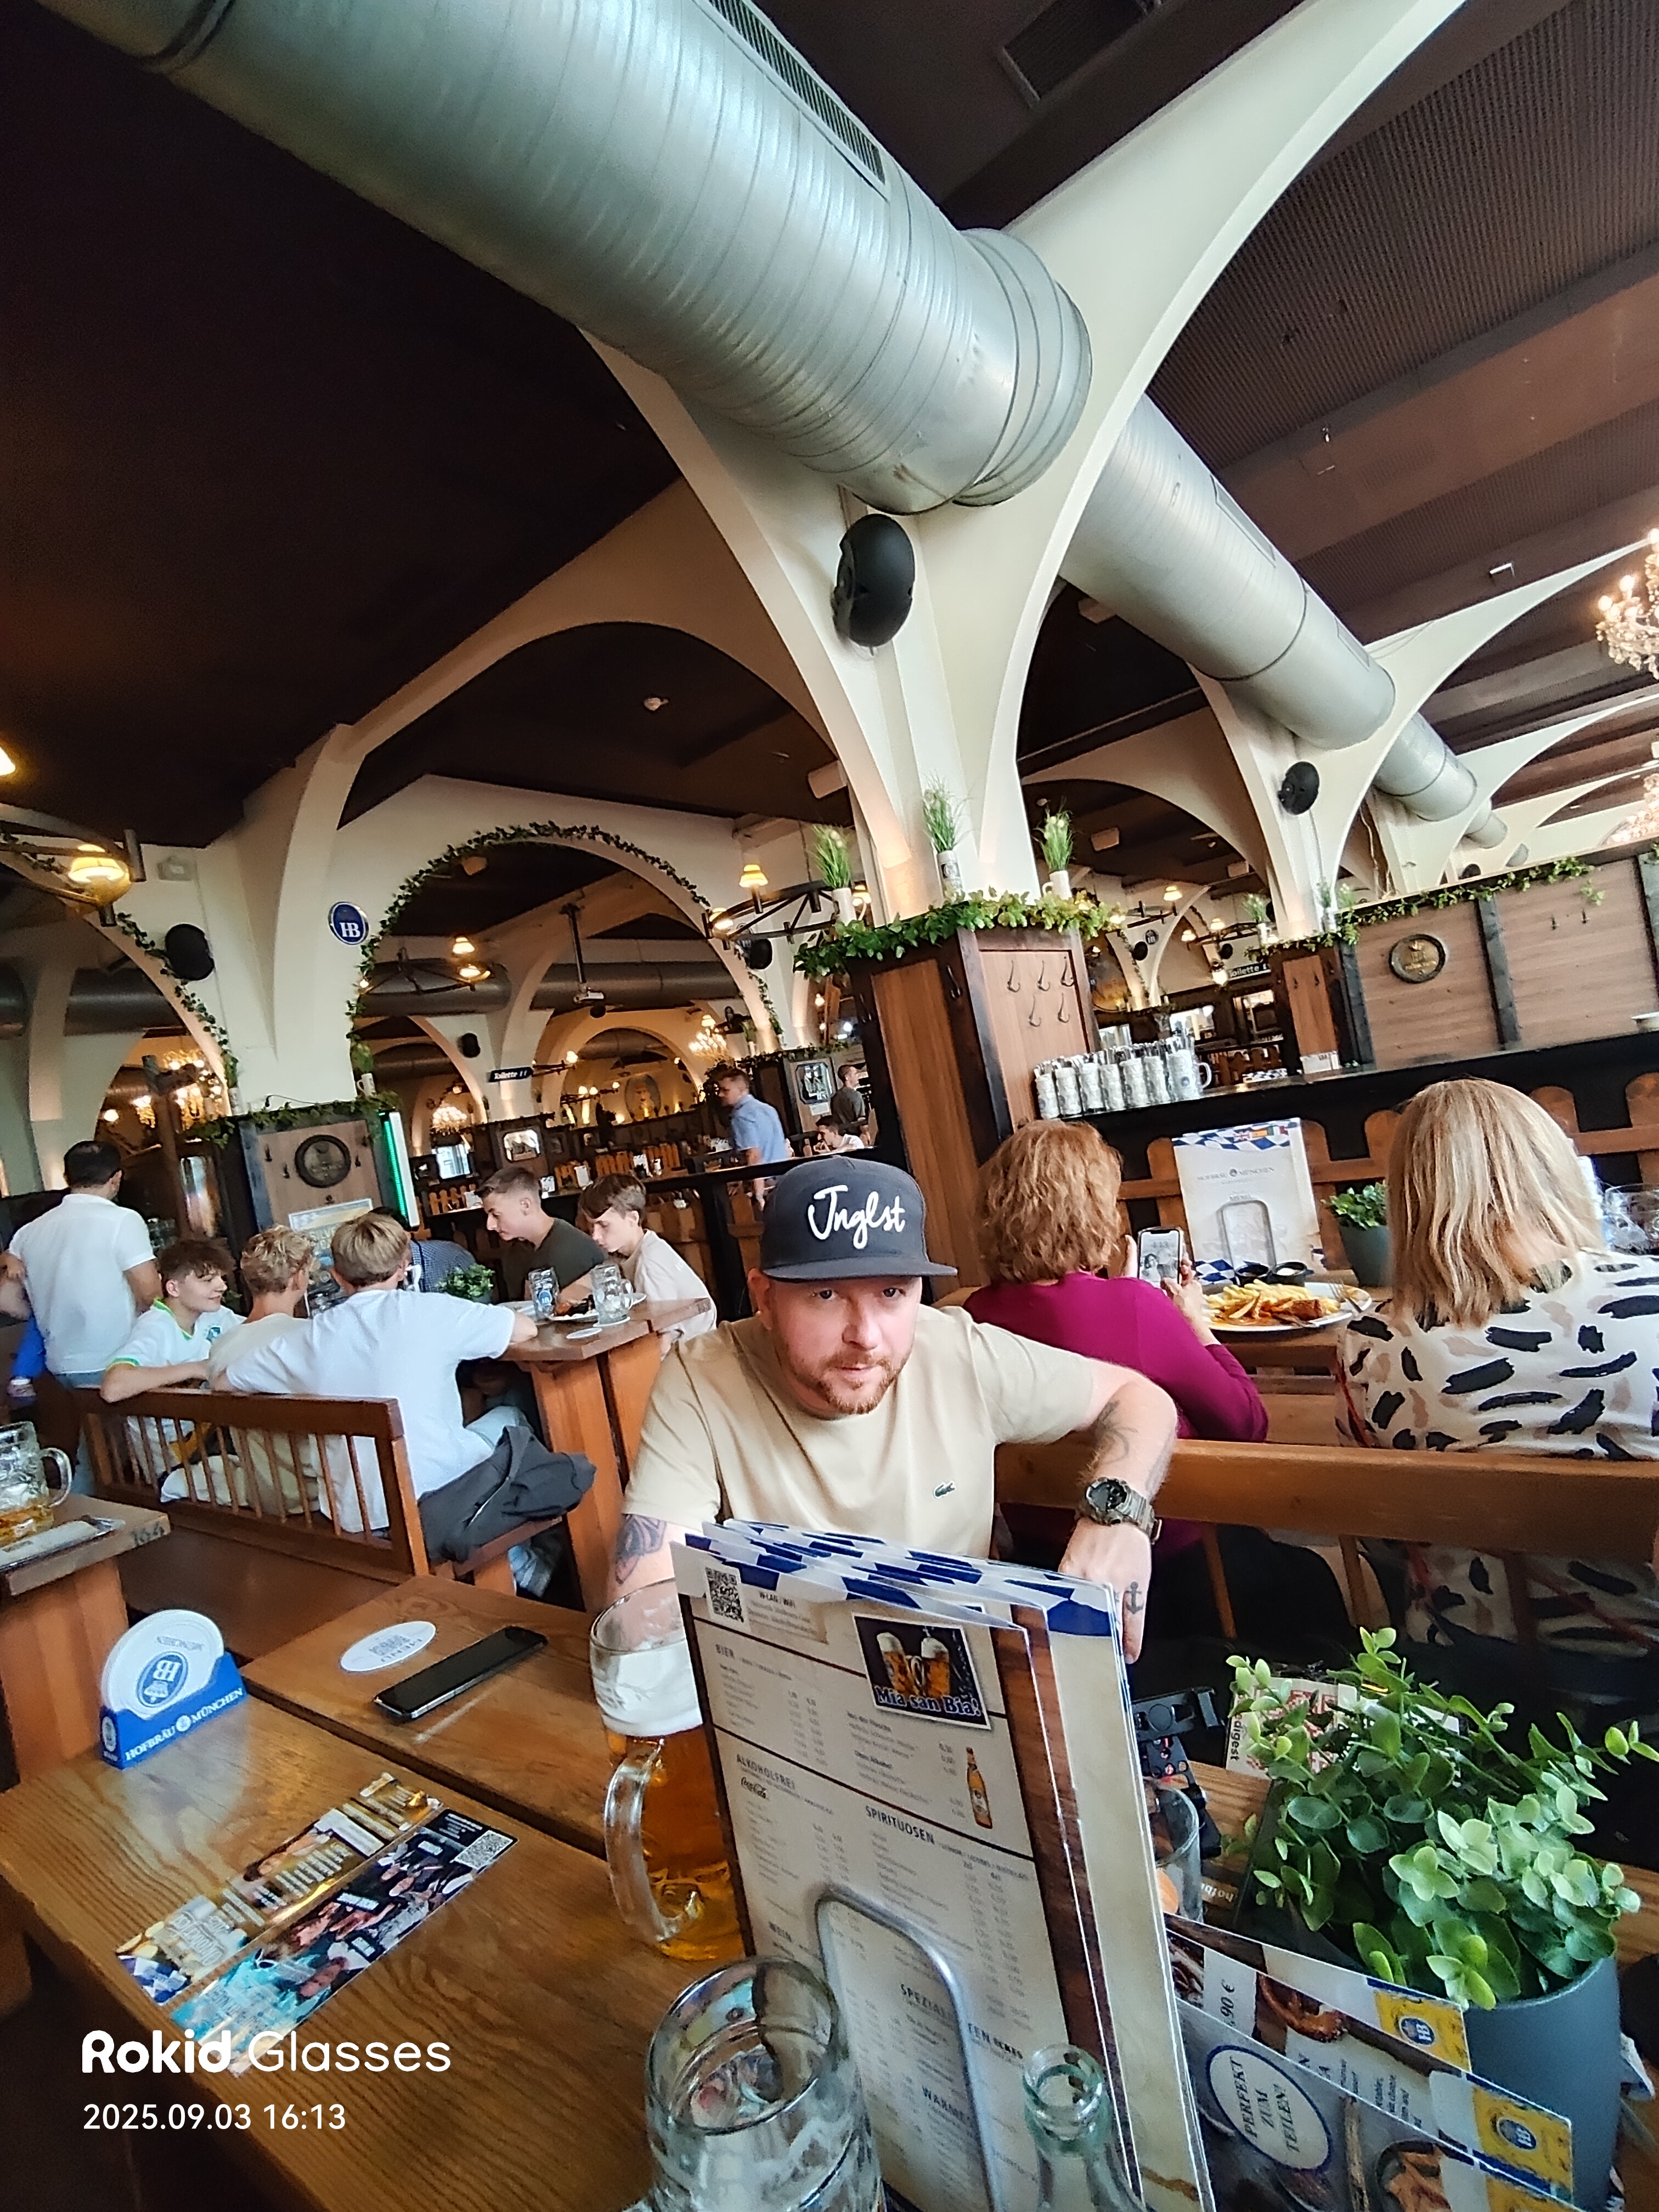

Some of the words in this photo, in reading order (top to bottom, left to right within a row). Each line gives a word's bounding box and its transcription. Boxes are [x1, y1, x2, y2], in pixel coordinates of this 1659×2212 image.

[340, 922, 360, 938] HB
[874, 1686, 907, 1707] Mia
[909, 1696, 940, 1712] san
[125, 1727, 177, 1761] HOFBRÄU
[190, 1687, 244, 1724] MÜNCHEN
[737, 1754, 795, 1790] ALKOHOLFREI
[865, 1805, 935, 1845] SPIRITUOSEN
[1229, 2056, 1257, 2138] PERFEKT
[1255, 2087, 1275, 2129] ZUM
